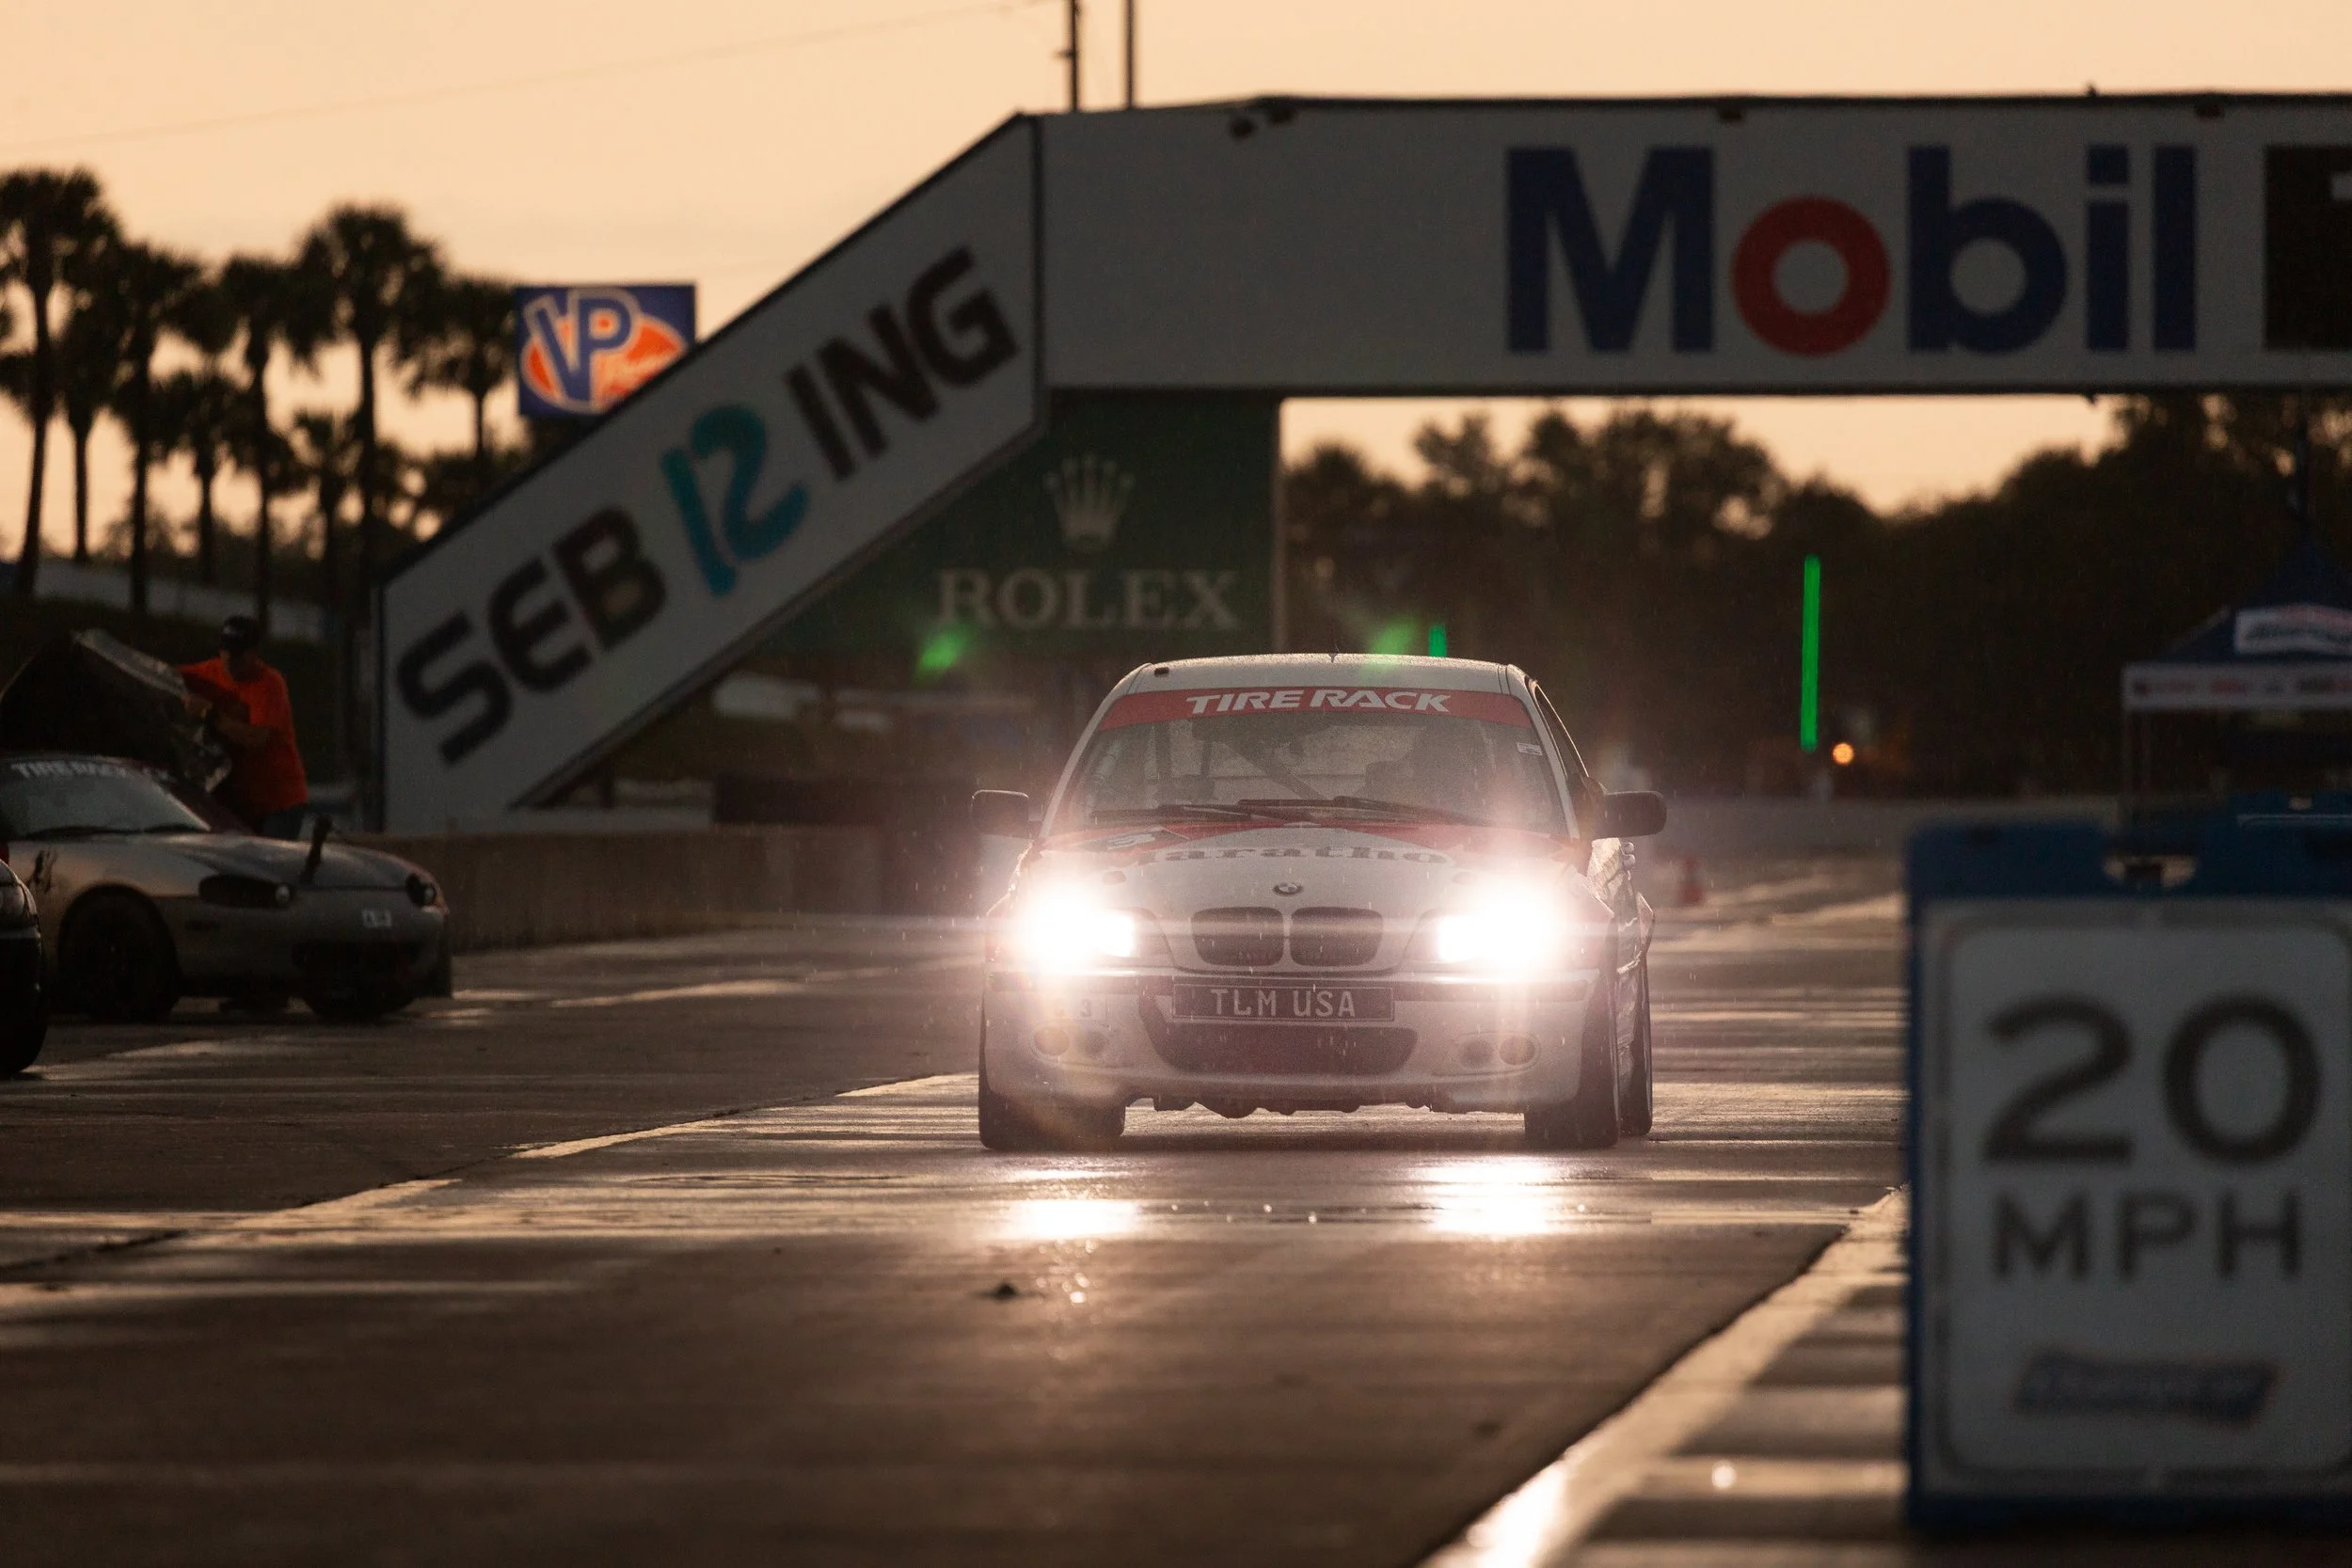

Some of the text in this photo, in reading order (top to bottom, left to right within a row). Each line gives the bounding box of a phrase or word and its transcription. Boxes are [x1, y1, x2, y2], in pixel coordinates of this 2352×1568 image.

[1507, 143, 2198, 356] Mobil
[526, 291, 638, 406] VP
[940, 566, 1239, 629] ROLEX
[1185, 689, 1453, 715] TIRE RACK
[1211, 988, 1356, 1018] TLM USA
[1982, 993, 2321, 1165] 20
[1992, 1189, 2304, 1282] MPH
